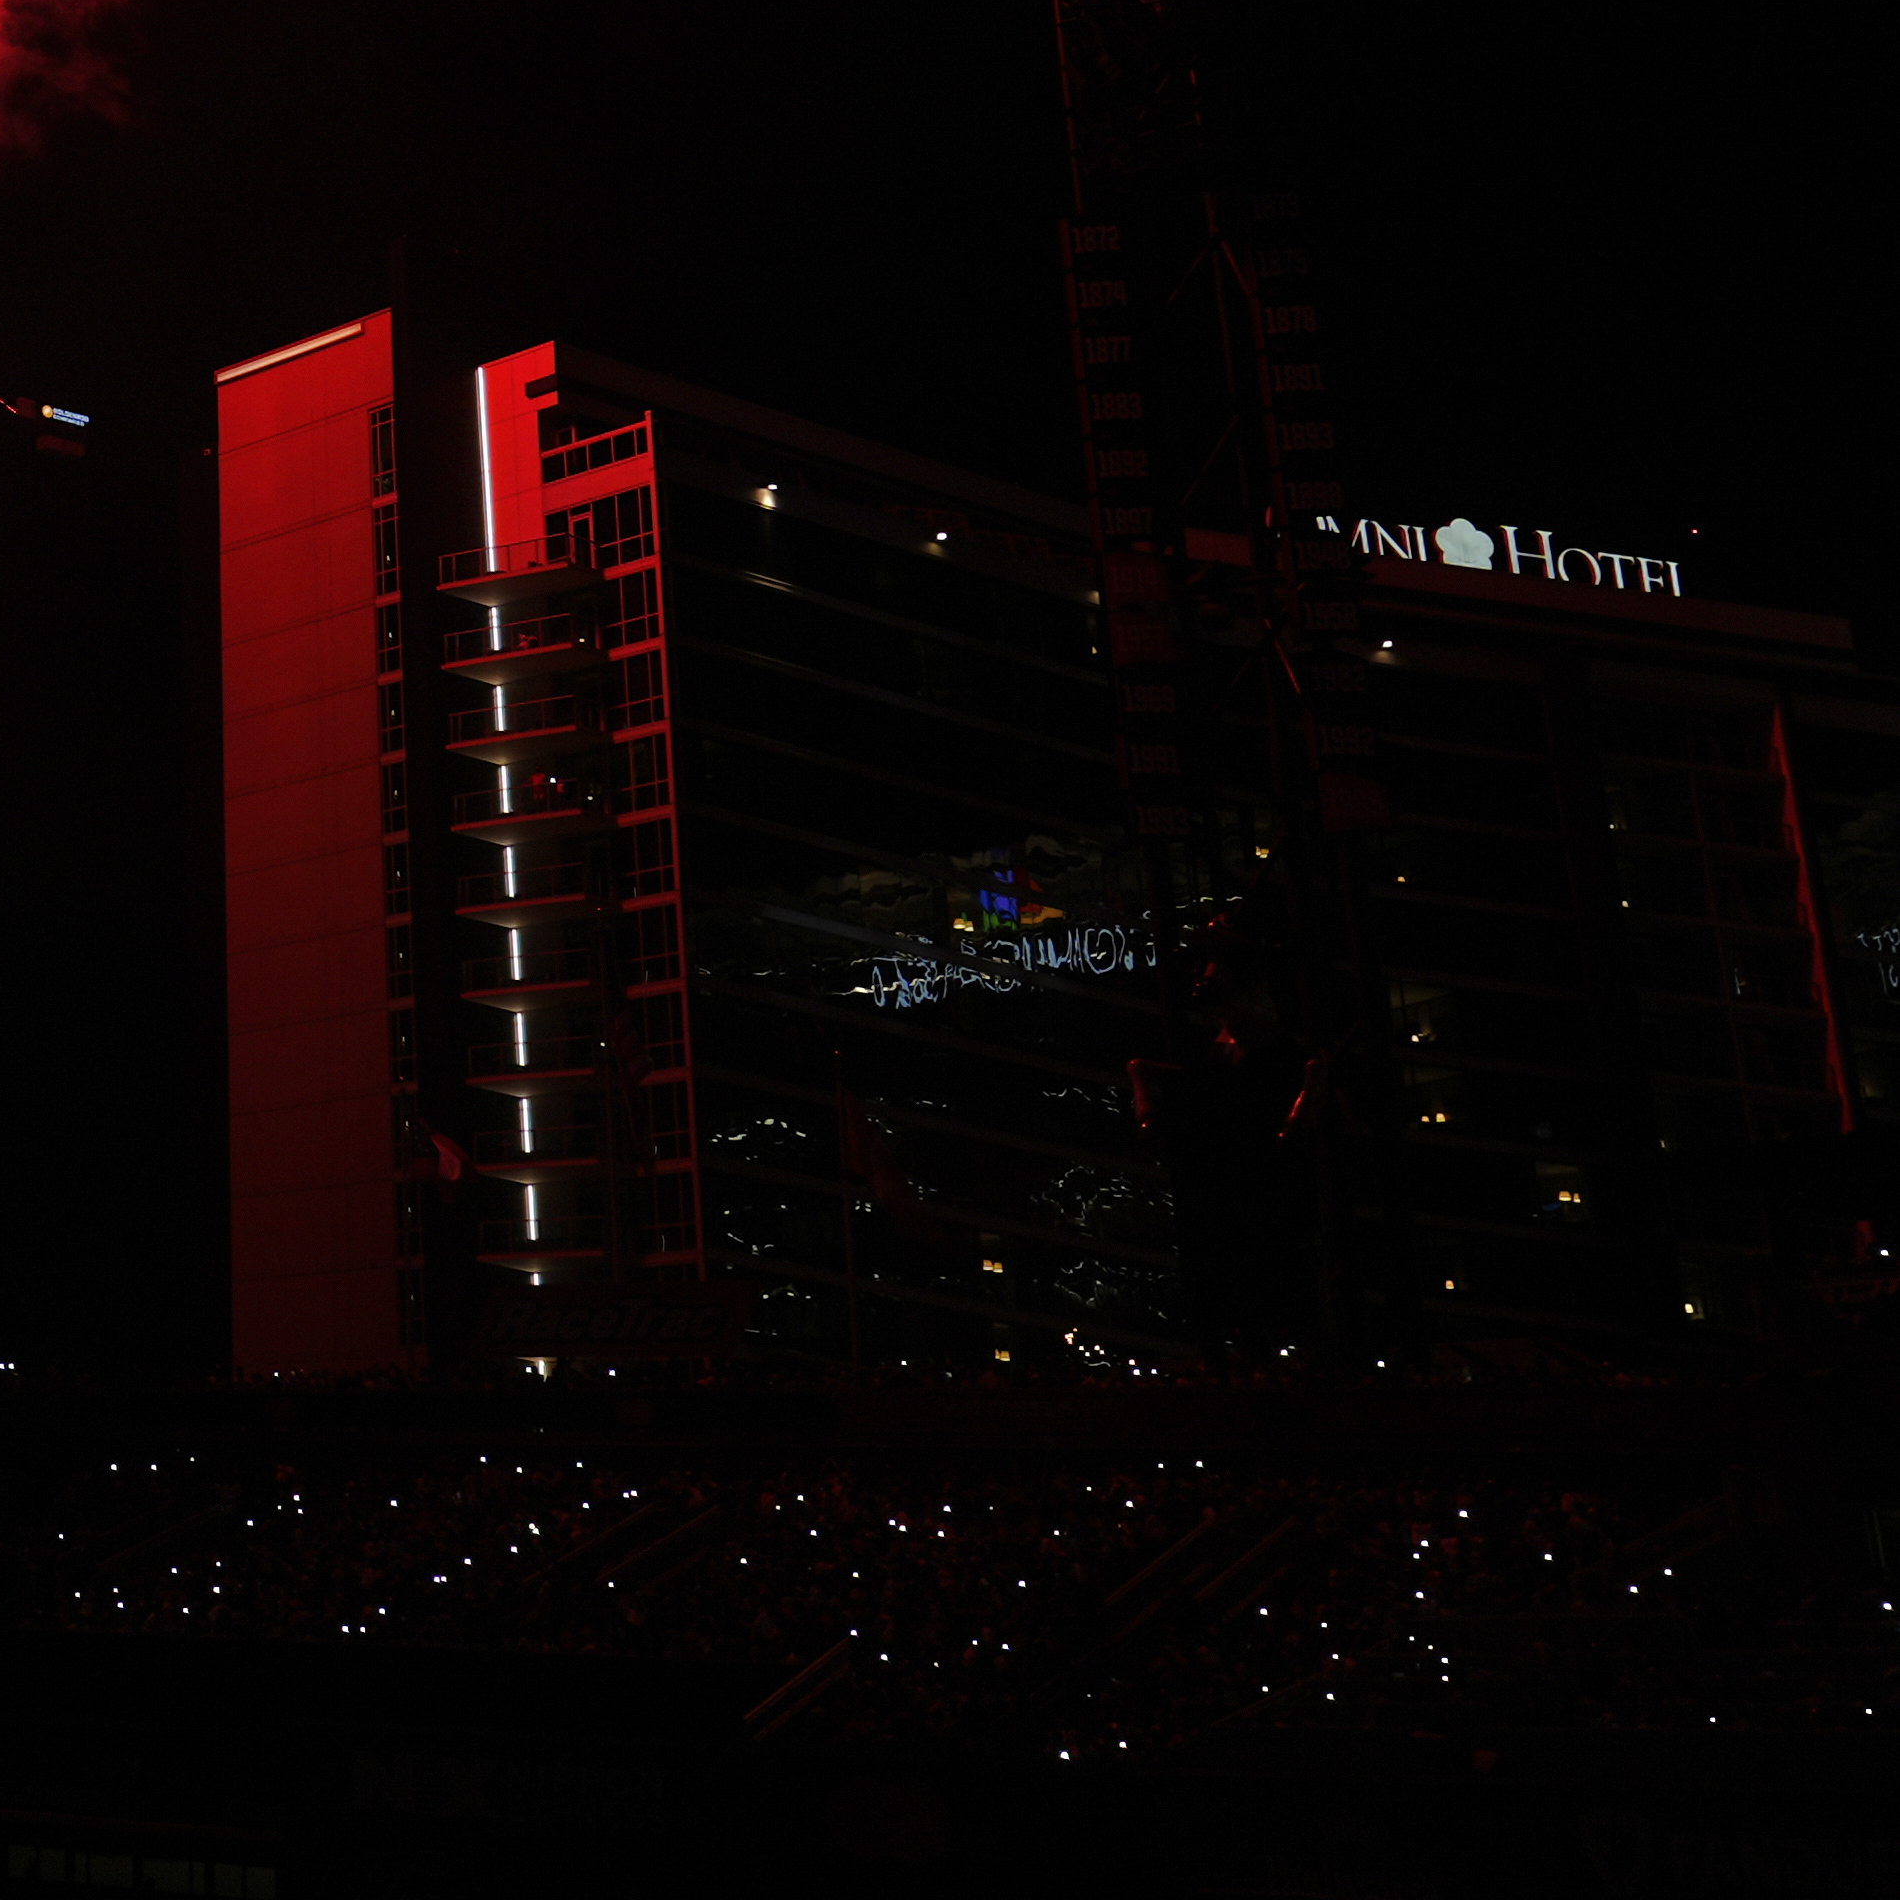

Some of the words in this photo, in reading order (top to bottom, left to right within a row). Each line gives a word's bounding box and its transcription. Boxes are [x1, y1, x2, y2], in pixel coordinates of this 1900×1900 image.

[1071, 224, 1122, 254] 1872
[1264, 305, 1320, 335] 1878
[1084, 335, 1132, 364] 1877
[1271, 362, 1326, 393] 1891
[1090, 391, 1145, 421] 1883
[1278, 421, 1336, 451] 1893
[1096, 449, 1149, 478] 1892
[1103, 506, 1154, 537] 1897
[1316, 515, 1426, 562] MNI
[1129, 744, 1181, 774] 1991
[491, 1297, 727, 1342] RaceTrac
